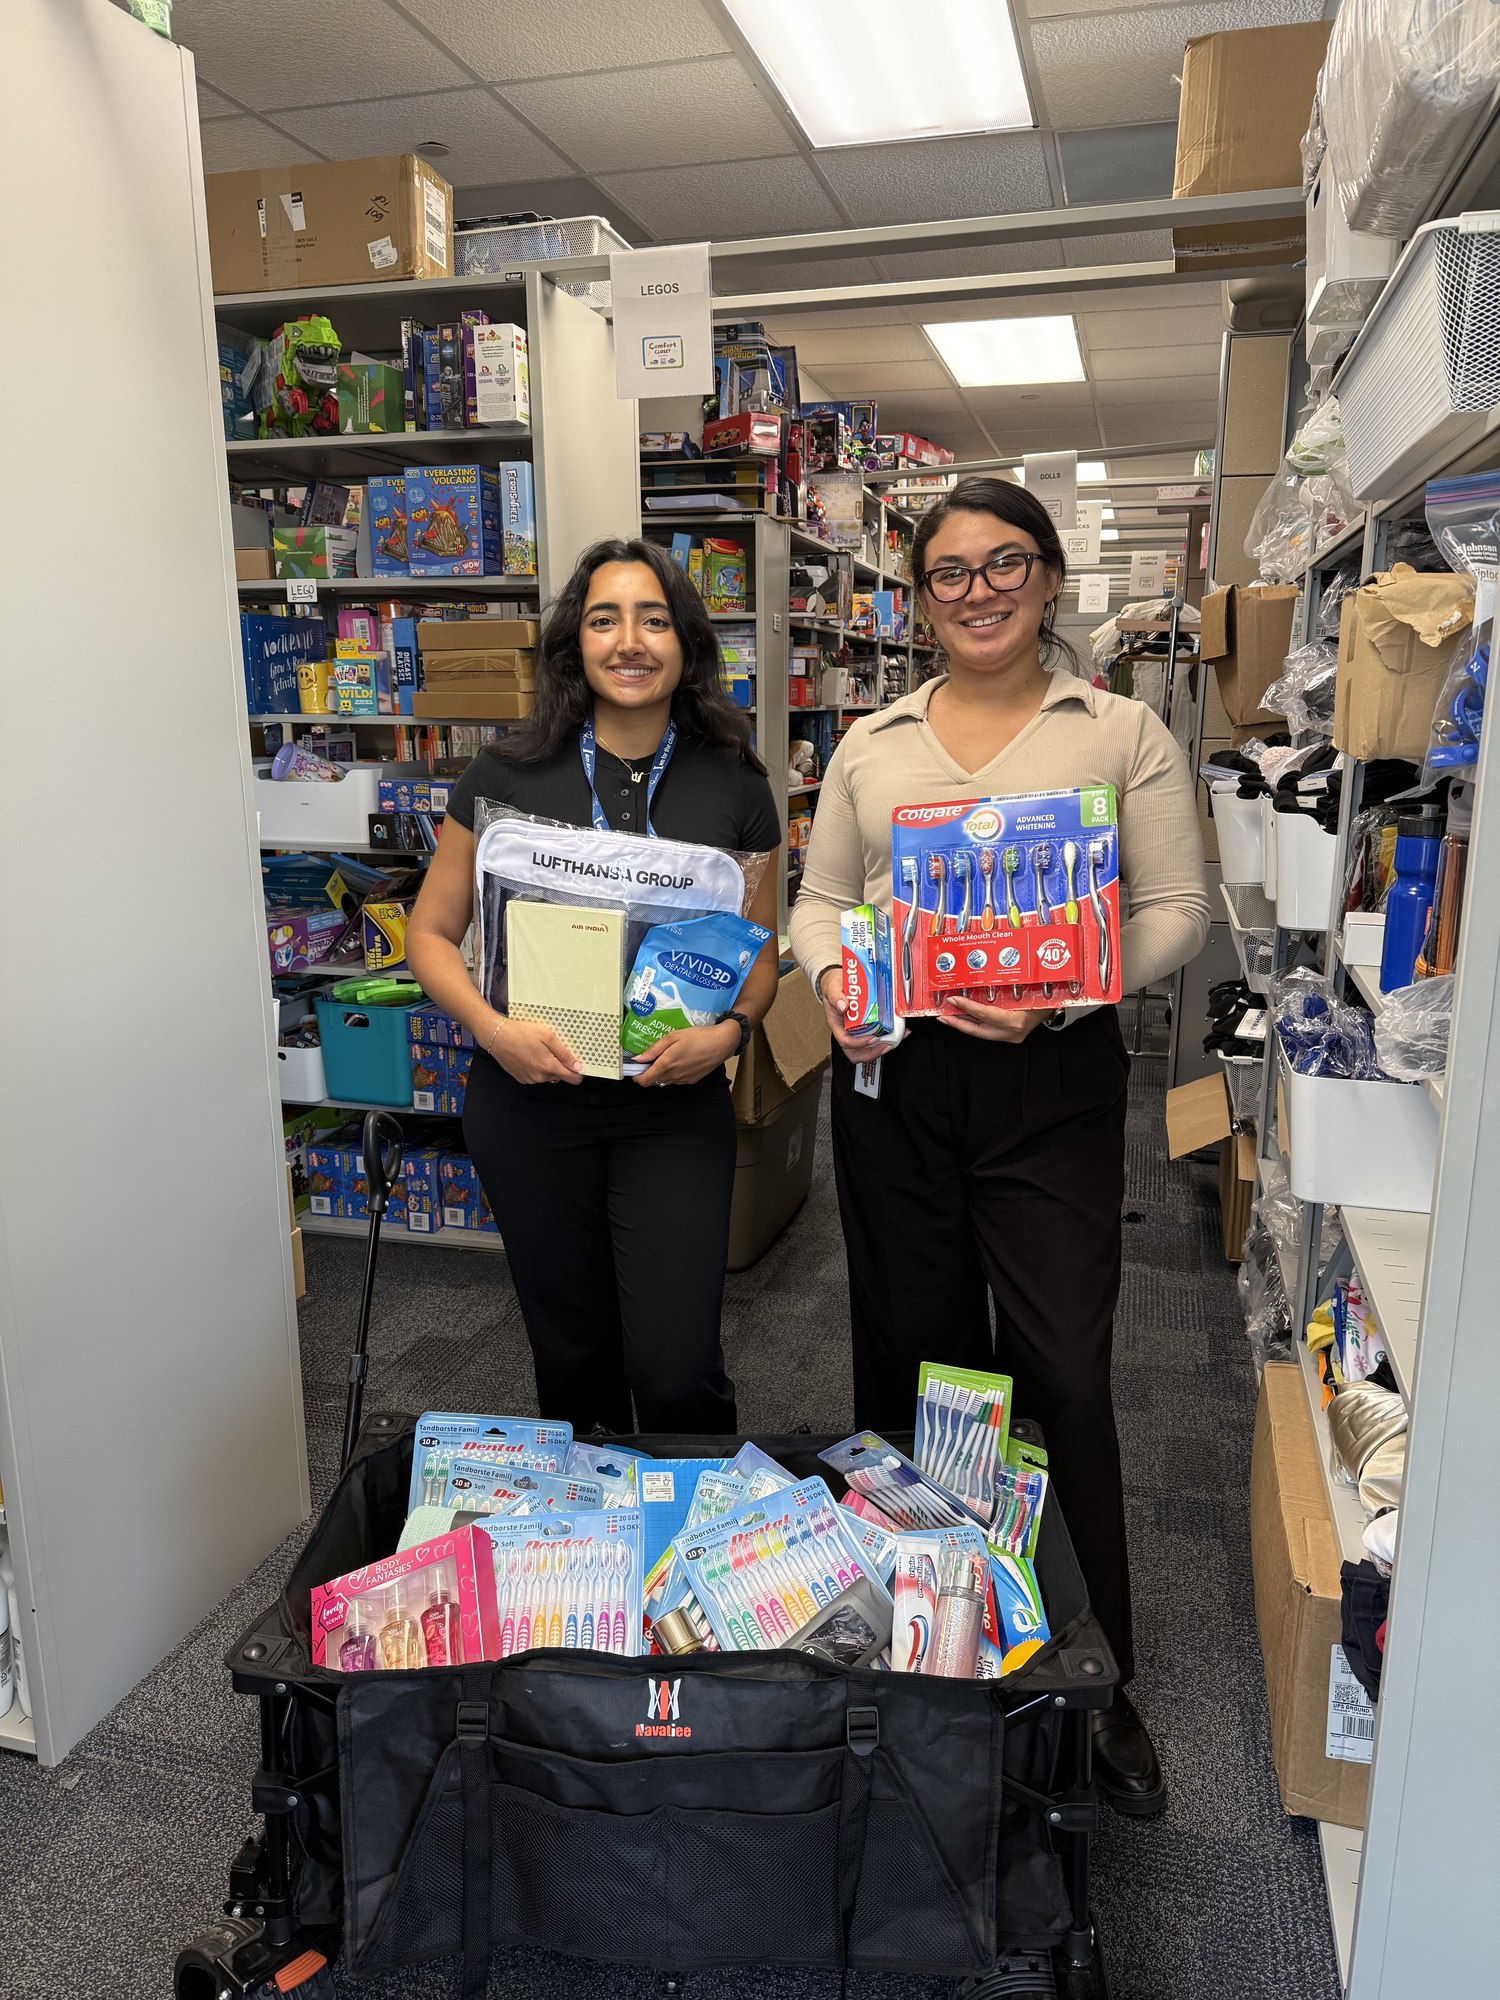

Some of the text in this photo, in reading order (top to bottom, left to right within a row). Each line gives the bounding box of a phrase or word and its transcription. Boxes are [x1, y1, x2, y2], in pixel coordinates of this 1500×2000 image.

[641, 283, 679, 296] LEGOS
[649, 342, 677, 350] Comfort
[406, 471, 420, 479] KIDS
[424, 468, 477, 477] EVERLASTING
[1040, 472, 1061, 481] DOLLS
[433, 475, 477, 485] VOLCANO
[411, 508, 427, 521] POP!
[375, 517, 390, 527] POP!
[462, 562, 480, 570] WOW
[290, 585, 315, 596] LEGO
[270, 662, 286, 679] Grow
[396, 651, 406, 682] PLAYSET
[403, 651, 412, 681] DIECAST
[273, 674, 296, 696] Activity
[338, 689, 373, 699] WILD!
[1093, 797, 1108, 816] 8
[897, 805, 963, 822] Colgate
[1016, 814, 1055, 824] ADVANCED
[1091, 815, 1110, 824] PACK
[964, 819, 995, 833] Total
[1015, 821, 1056, 832] WHITENING
[532, 851, 694, 891] LUFTHANSA GROUP
[584, 925, 605, 933] INDIA
[748, 925, 770, 940] 200
[851, 921, 859, 945] Triple
[858, 921, 866, 948] Action
[941, 931, 1013, 944] Whole Mouth Clean
[373, 934, 383, 969] WASHER
[1043, 948, 1065, 962] 40%
[367, 948, 376, 969] TOSS
[671, 948, 731, 984] VIVID3D
[664, 961, 691, 978] DENTAL
[692, 972, 712, 987] FLOSS
[846, 957, 862, 1022] Colgate
[634, 1003, 650, 1013] MINT
[631, 1020, 656, 1036] FRESH
[419, 1425, 459, 1433] Tandborste
[463, 1441, 525, 1453] Dental
[453, 1464, 513, 1481] Tandborste Familj
[473, 1483, 486, 1491] Soft
[586, 1487, 598, 1495] SEK
[801, 1481, 822, 1495] 20 SEK
[584, 1496, 597, 1504] DKK
[813, 1489, 827, 1499] DKK
[627, 1514, 641, 1522] SEK
[716, 1517, 739, 1532] Familj
[481, 1522, 543, 1532] andborste Familj
[618, 1523, 641, 1532] 15 DKK
[731, 1513, 790, 1545] Dental
[501, 1540, 515, 1548] Soft
[524, 1536, 594, 1550] Dental
[707, 1539, 729, 1550] Medium
[876, 1534, 885, 1542] 20
[873, 1542, 881, 1550] 15
[687, 1550, 697, 1558] 10
[374, 1557, 401, 1575] BODY
[366, 1561, 412, 1587] FANTASIES
[322, 1601, 346, 1620] Lovely
[325, 1613, 344, 1627] SCENTS
[1345, 1705, 1370, 1713] GROUND
[635, 1723, 692, 1738] Navatiee
